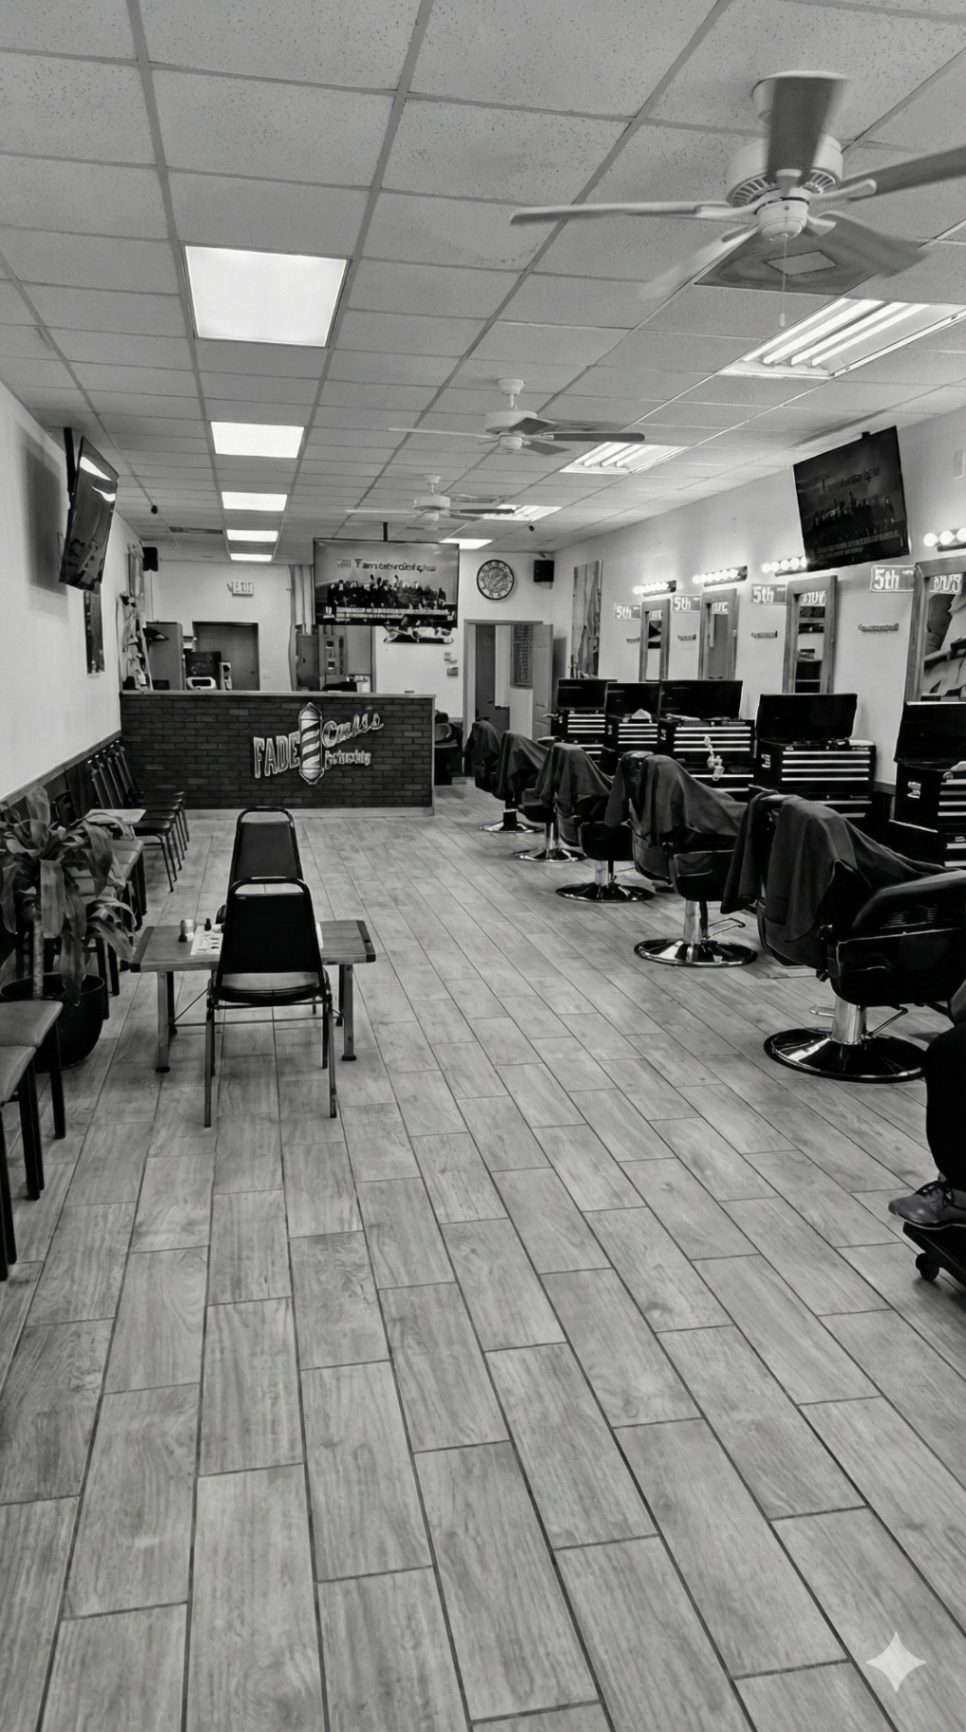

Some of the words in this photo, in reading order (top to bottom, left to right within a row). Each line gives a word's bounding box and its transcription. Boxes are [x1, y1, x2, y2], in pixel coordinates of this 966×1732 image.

[874, 568, 900, 590] 5th
[673, 596, 691, 611] 5th
[752, 586, 775, 604] 5th
[616, 605, 632, 619] 5th
[253, 730, 300, 779] FADE
